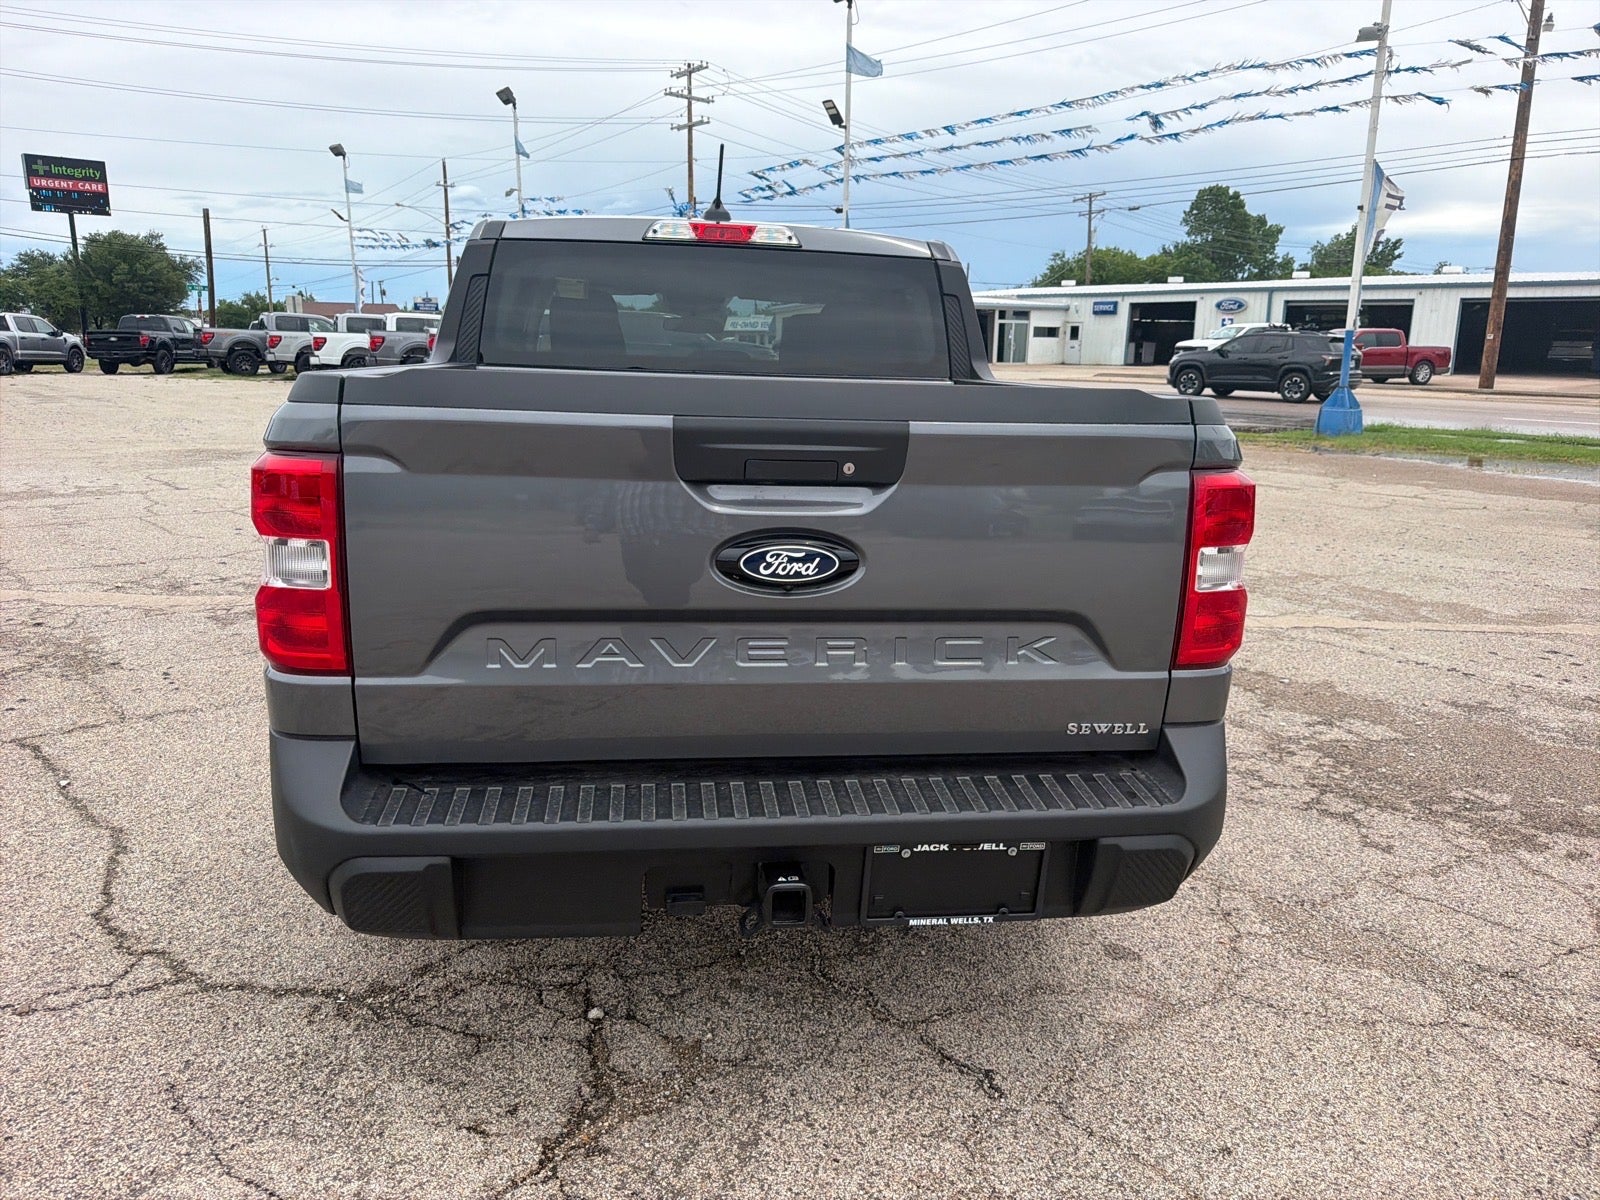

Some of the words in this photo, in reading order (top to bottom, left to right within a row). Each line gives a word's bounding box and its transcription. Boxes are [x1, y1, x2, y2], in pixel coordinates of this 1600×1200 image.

[51, 164, 101, 180] Integrity
[34, 178, 74, 188] URGENT
[78, 183, 103, 191] CARE
[759, 550, 821, 576] Ford
[486, 635, 1060, 668] MAVERICK
[1066, 722, 1149, 735] SEWELL
[912, 843, 950, 852] JACK
[952, 842, 1007, 851] ELL
[908, 918, 949, 926] MINERAL
[950, 916, 981, 925] WELLS,
[982, 916, 995, 924] TX
